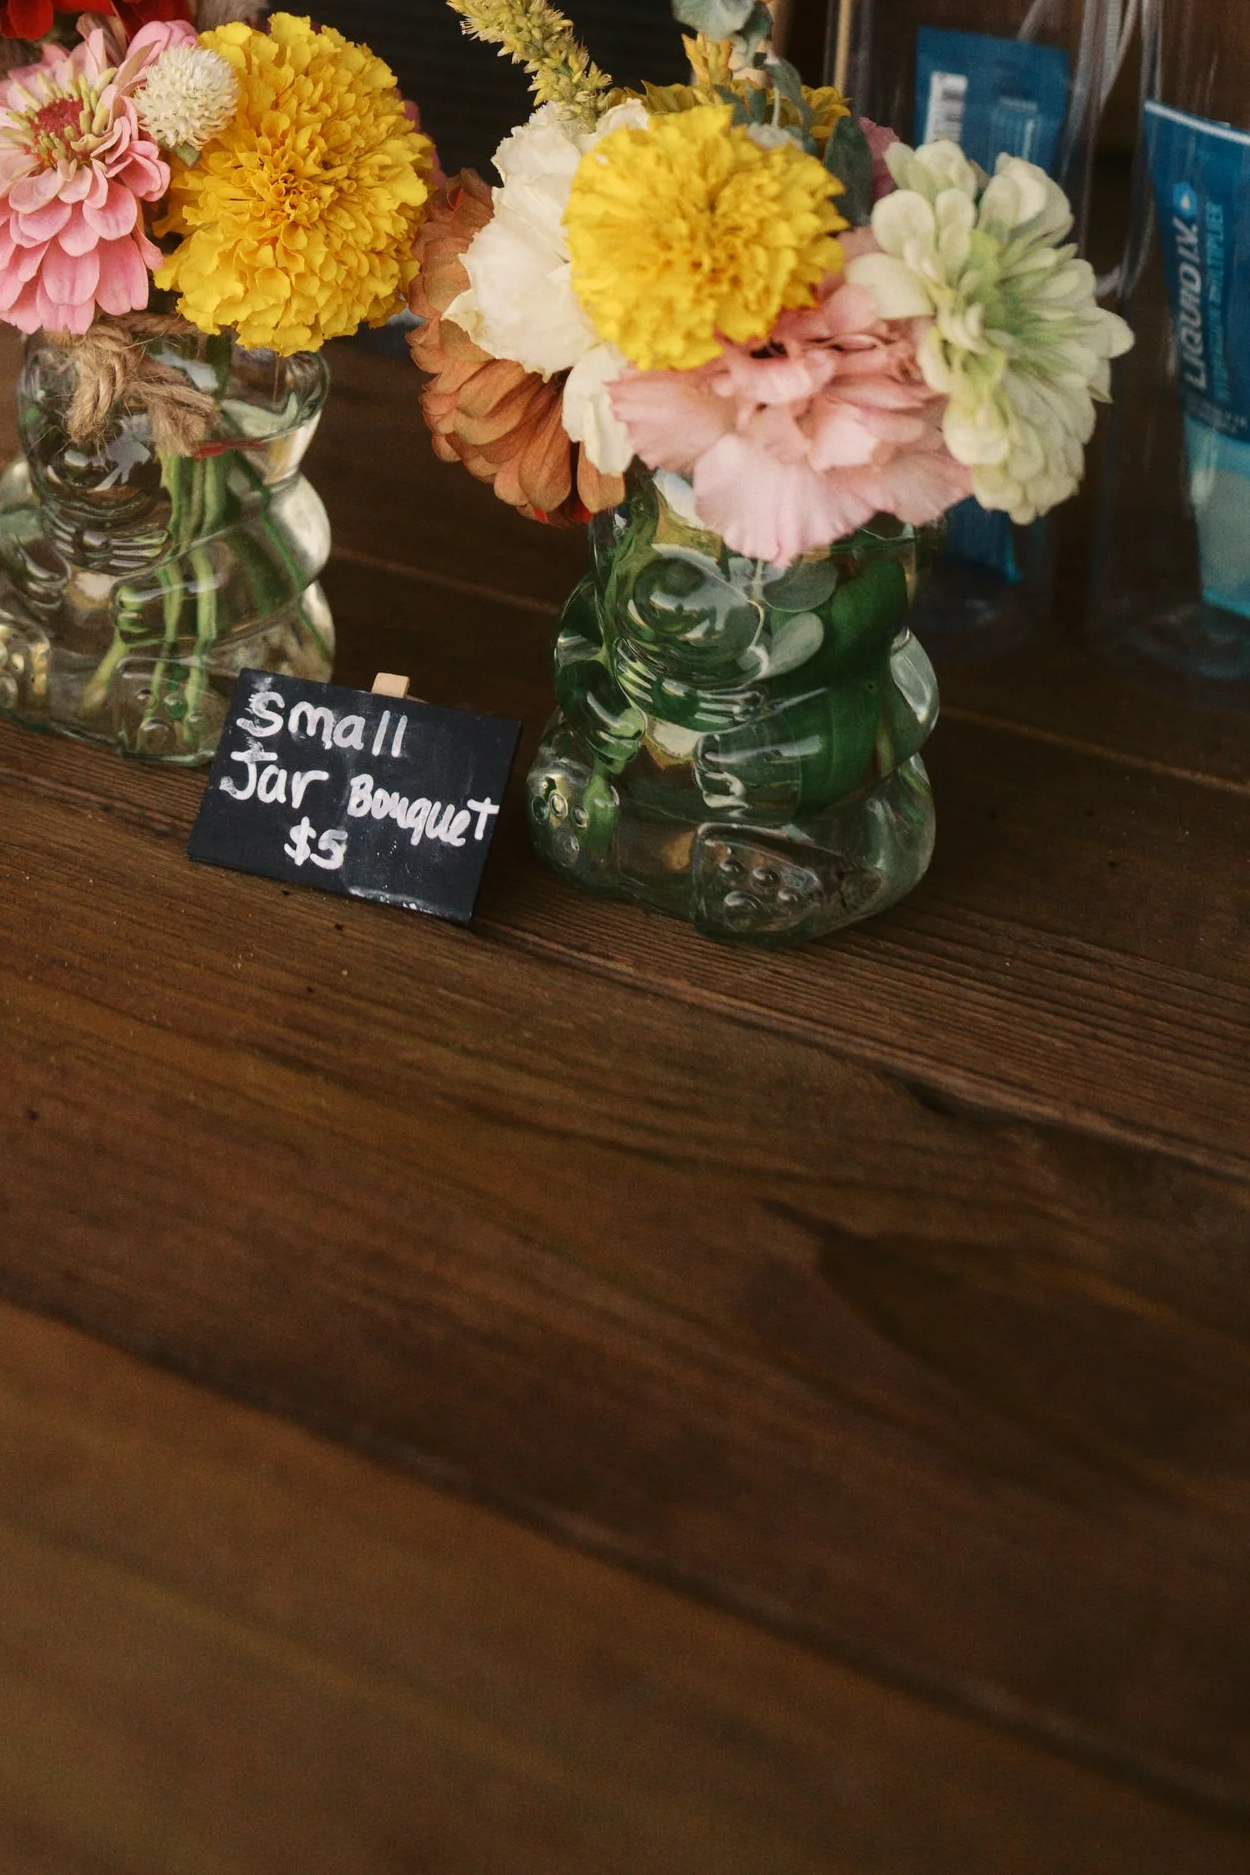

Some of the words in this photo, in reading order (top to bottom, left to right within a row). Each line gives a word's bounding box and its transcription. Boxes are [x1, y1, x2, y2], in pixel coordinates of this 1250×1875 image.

[1179, 262, 1208, 390] LIQUID
[236, 691, 408, 758] Small
[219, 751, 329, 809] Jar
[347, 773, 500, 847] Bouquet
[284, 816, 349, 870] $5
